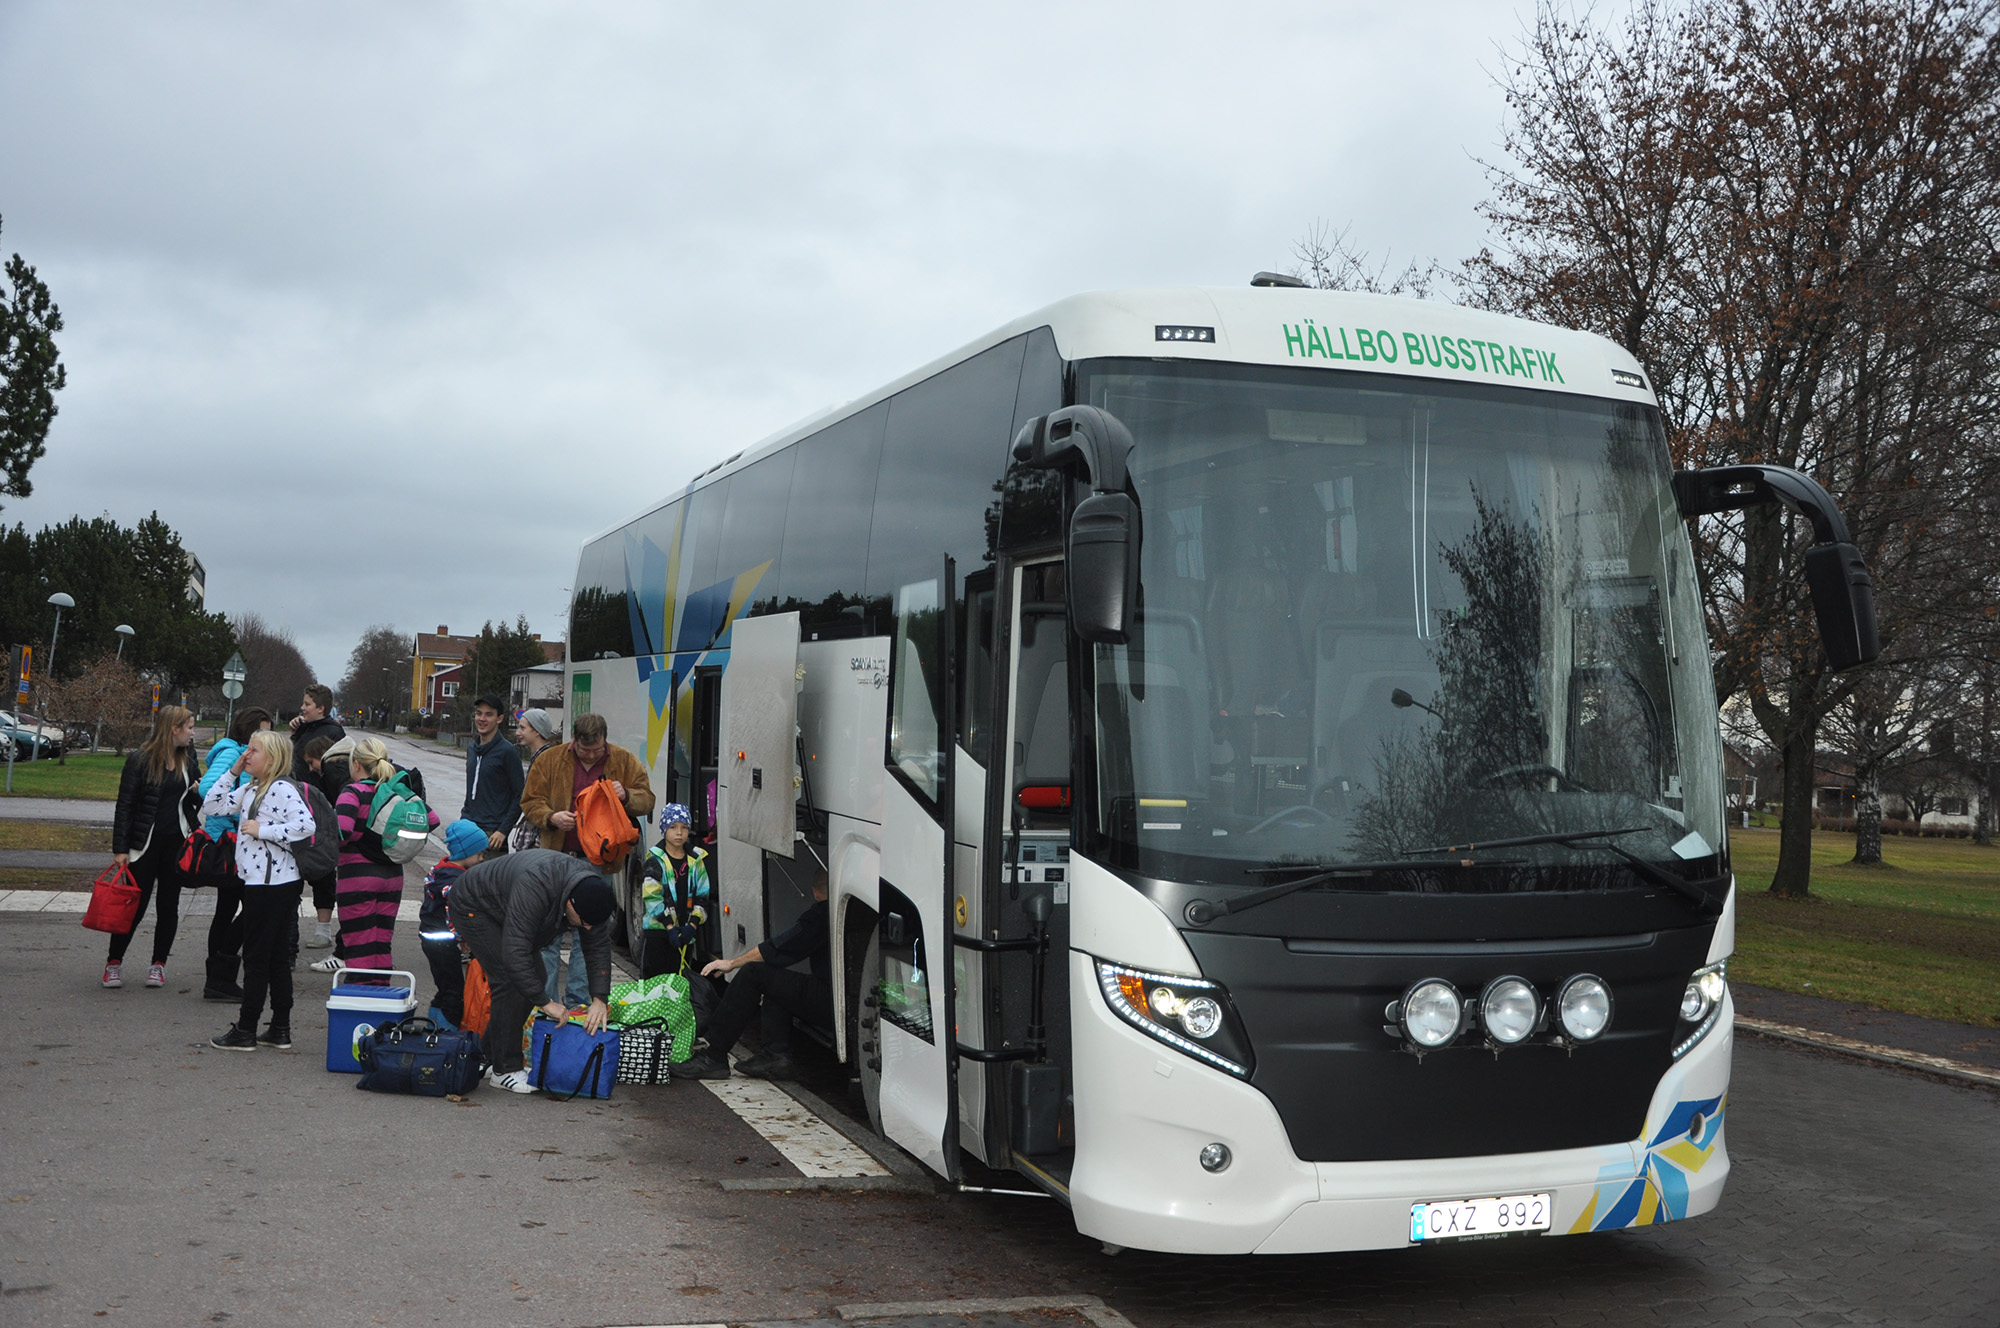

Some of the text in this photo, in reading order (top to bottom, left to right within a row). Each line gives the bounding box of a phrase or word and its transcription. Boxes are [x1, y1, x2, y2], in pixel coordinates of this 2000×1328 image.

[1282, 318, 1565, 384] HÄLLBO BUSSTRAFIK
[1430, 1201, 1543, 1233] CXZ 892
